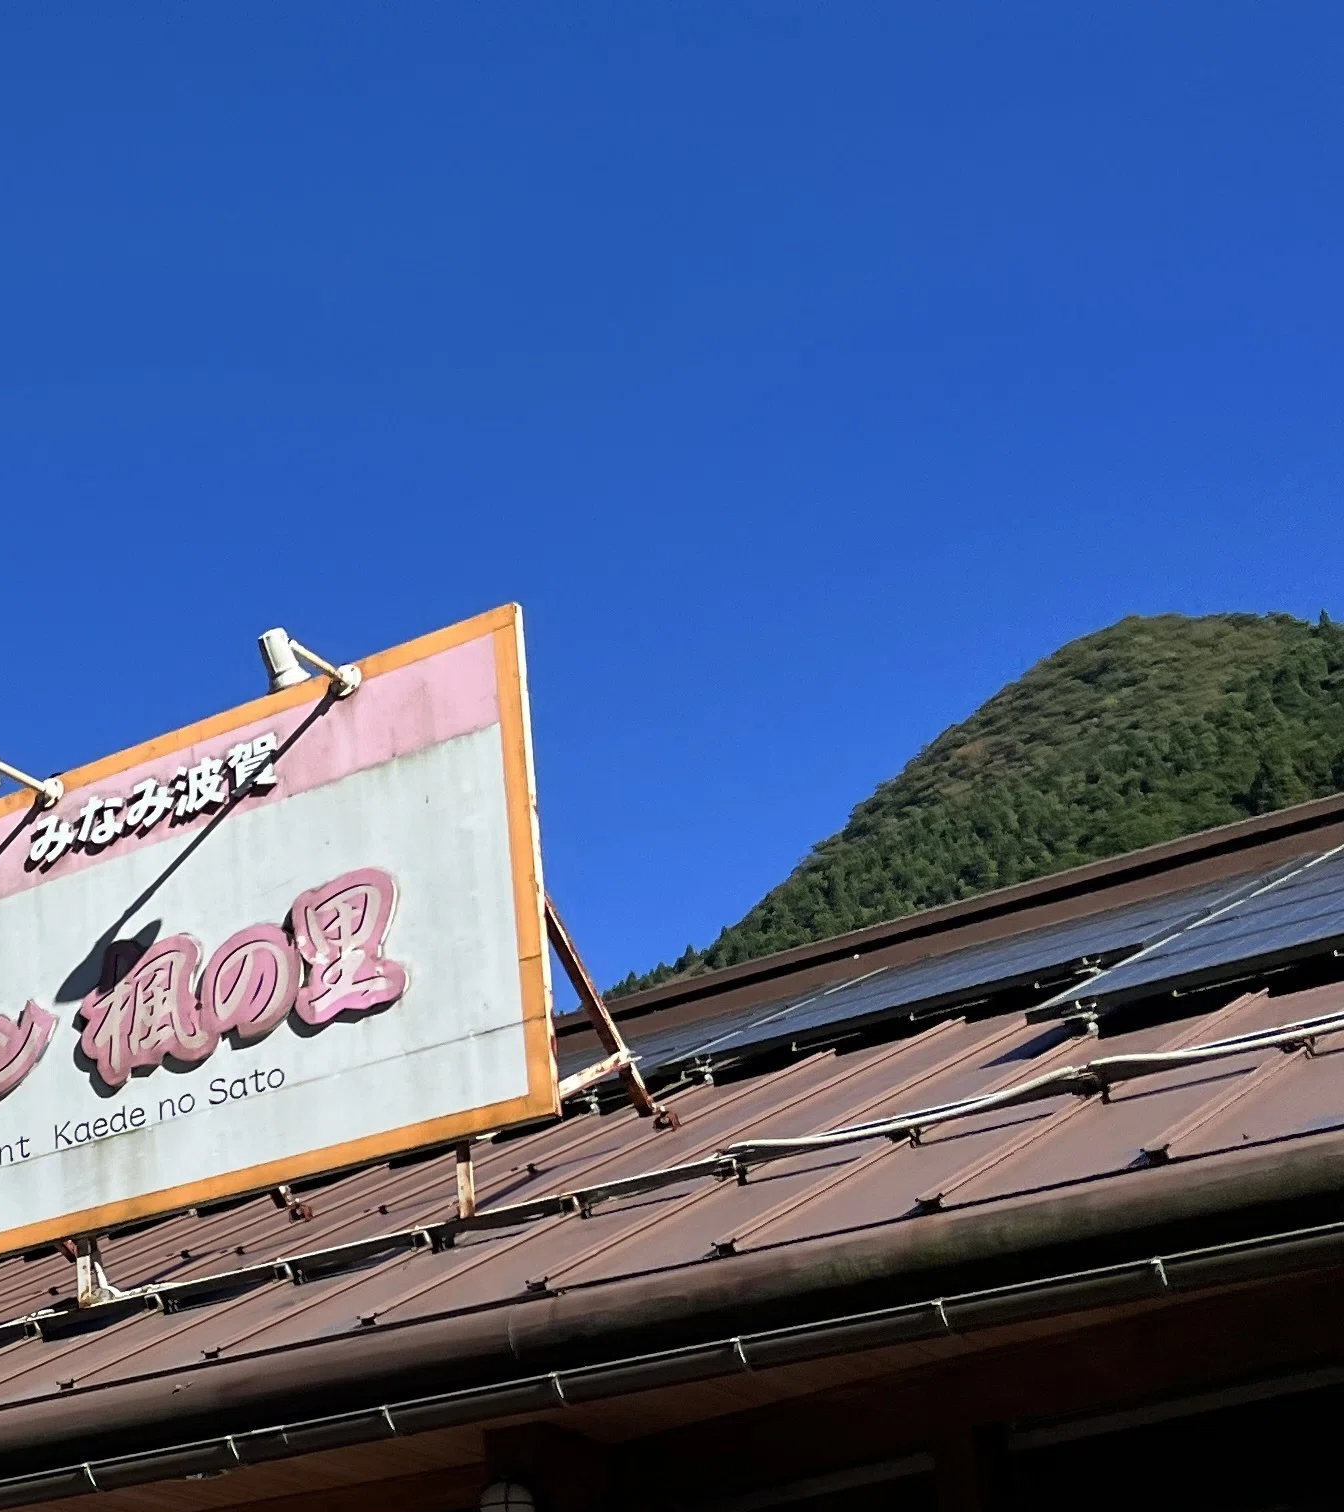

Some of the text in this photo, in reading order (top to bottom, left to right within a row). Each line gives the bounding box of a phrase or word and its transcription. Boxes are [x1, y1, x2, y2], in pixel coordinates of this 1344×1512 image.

[30, 733, 280, 863] みなみ波賀
[80, 870, 408, 1088] 楓の里
[52, 1101, 147, 1149] Kaede
[159, 1090, 197, 1123] no
[207, 1062, 286, 1106] Sato
